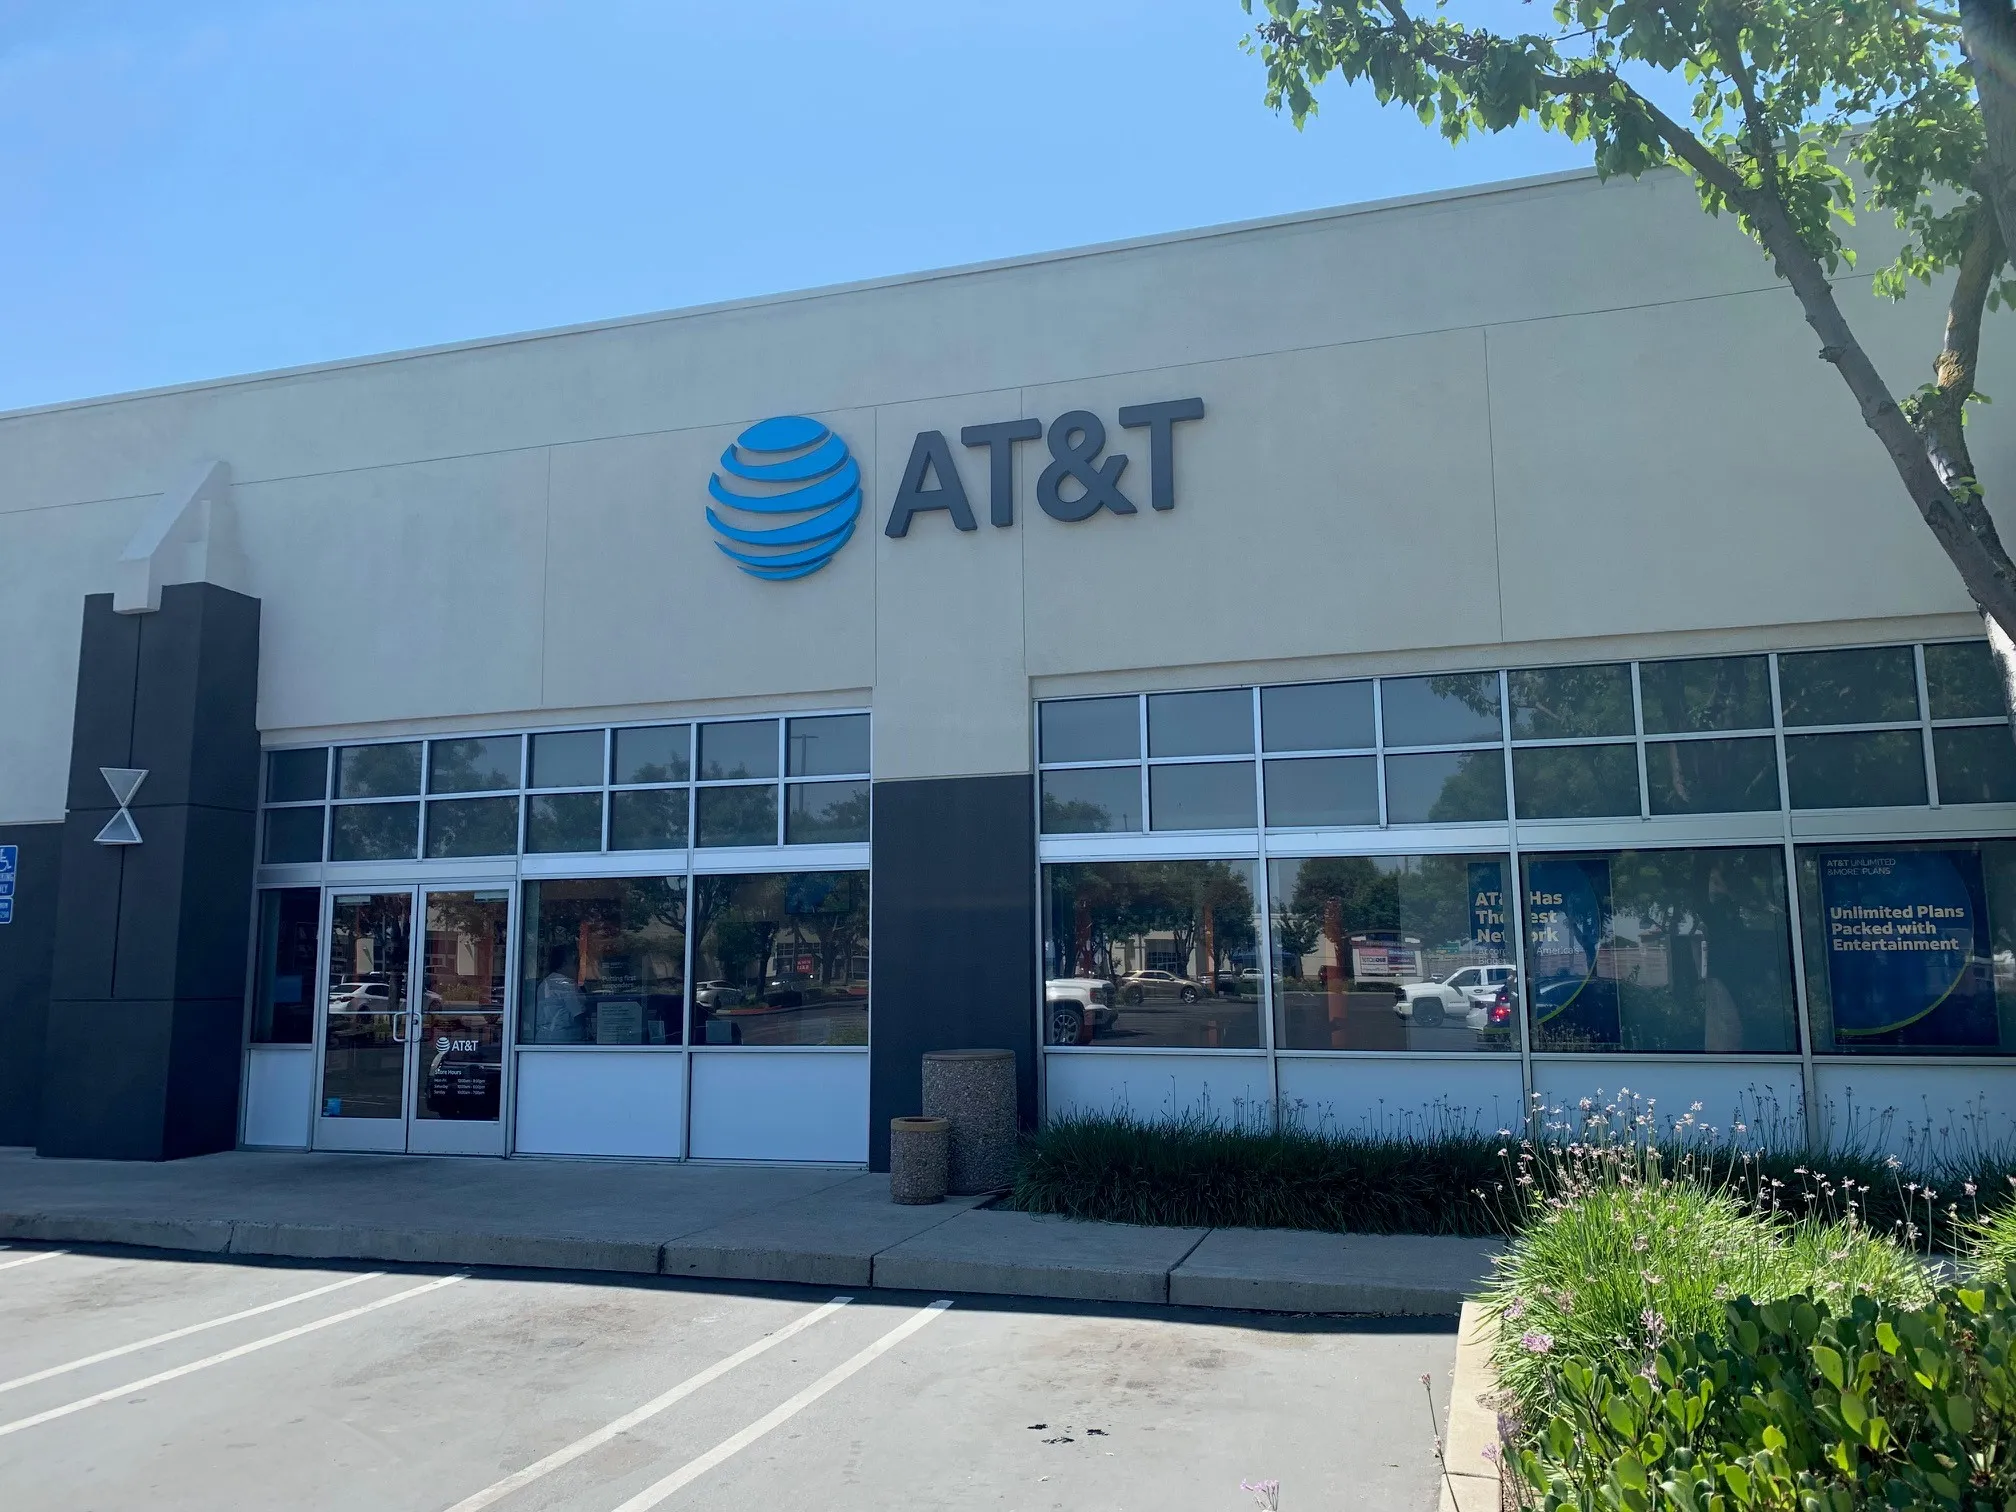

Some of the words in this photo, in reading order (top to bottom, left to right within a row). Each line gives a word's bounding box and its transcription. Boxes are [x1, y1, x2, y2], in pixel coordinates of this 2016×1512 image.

[885, 397, 1204, 538] AT&T
[1850, 858, 1896, 866] UNLIMITED
[1827, 868, 1860, 876] &MORE
[1862, 867, 1891, 875] PLANS
[1530, 891, 1563, 906] Has
[1530, 909, 1558, 924] est
[1830, 905, 1914, 920] Unlimited
[1917, 904, 1965, 918] Plans
[1832, 922, 1893, 935] Packed
[1897, 921, 1937, 935] with
[1833, 938, 1960, 951] Entertainment
[451, 1040, 479, 1052] AT&T
